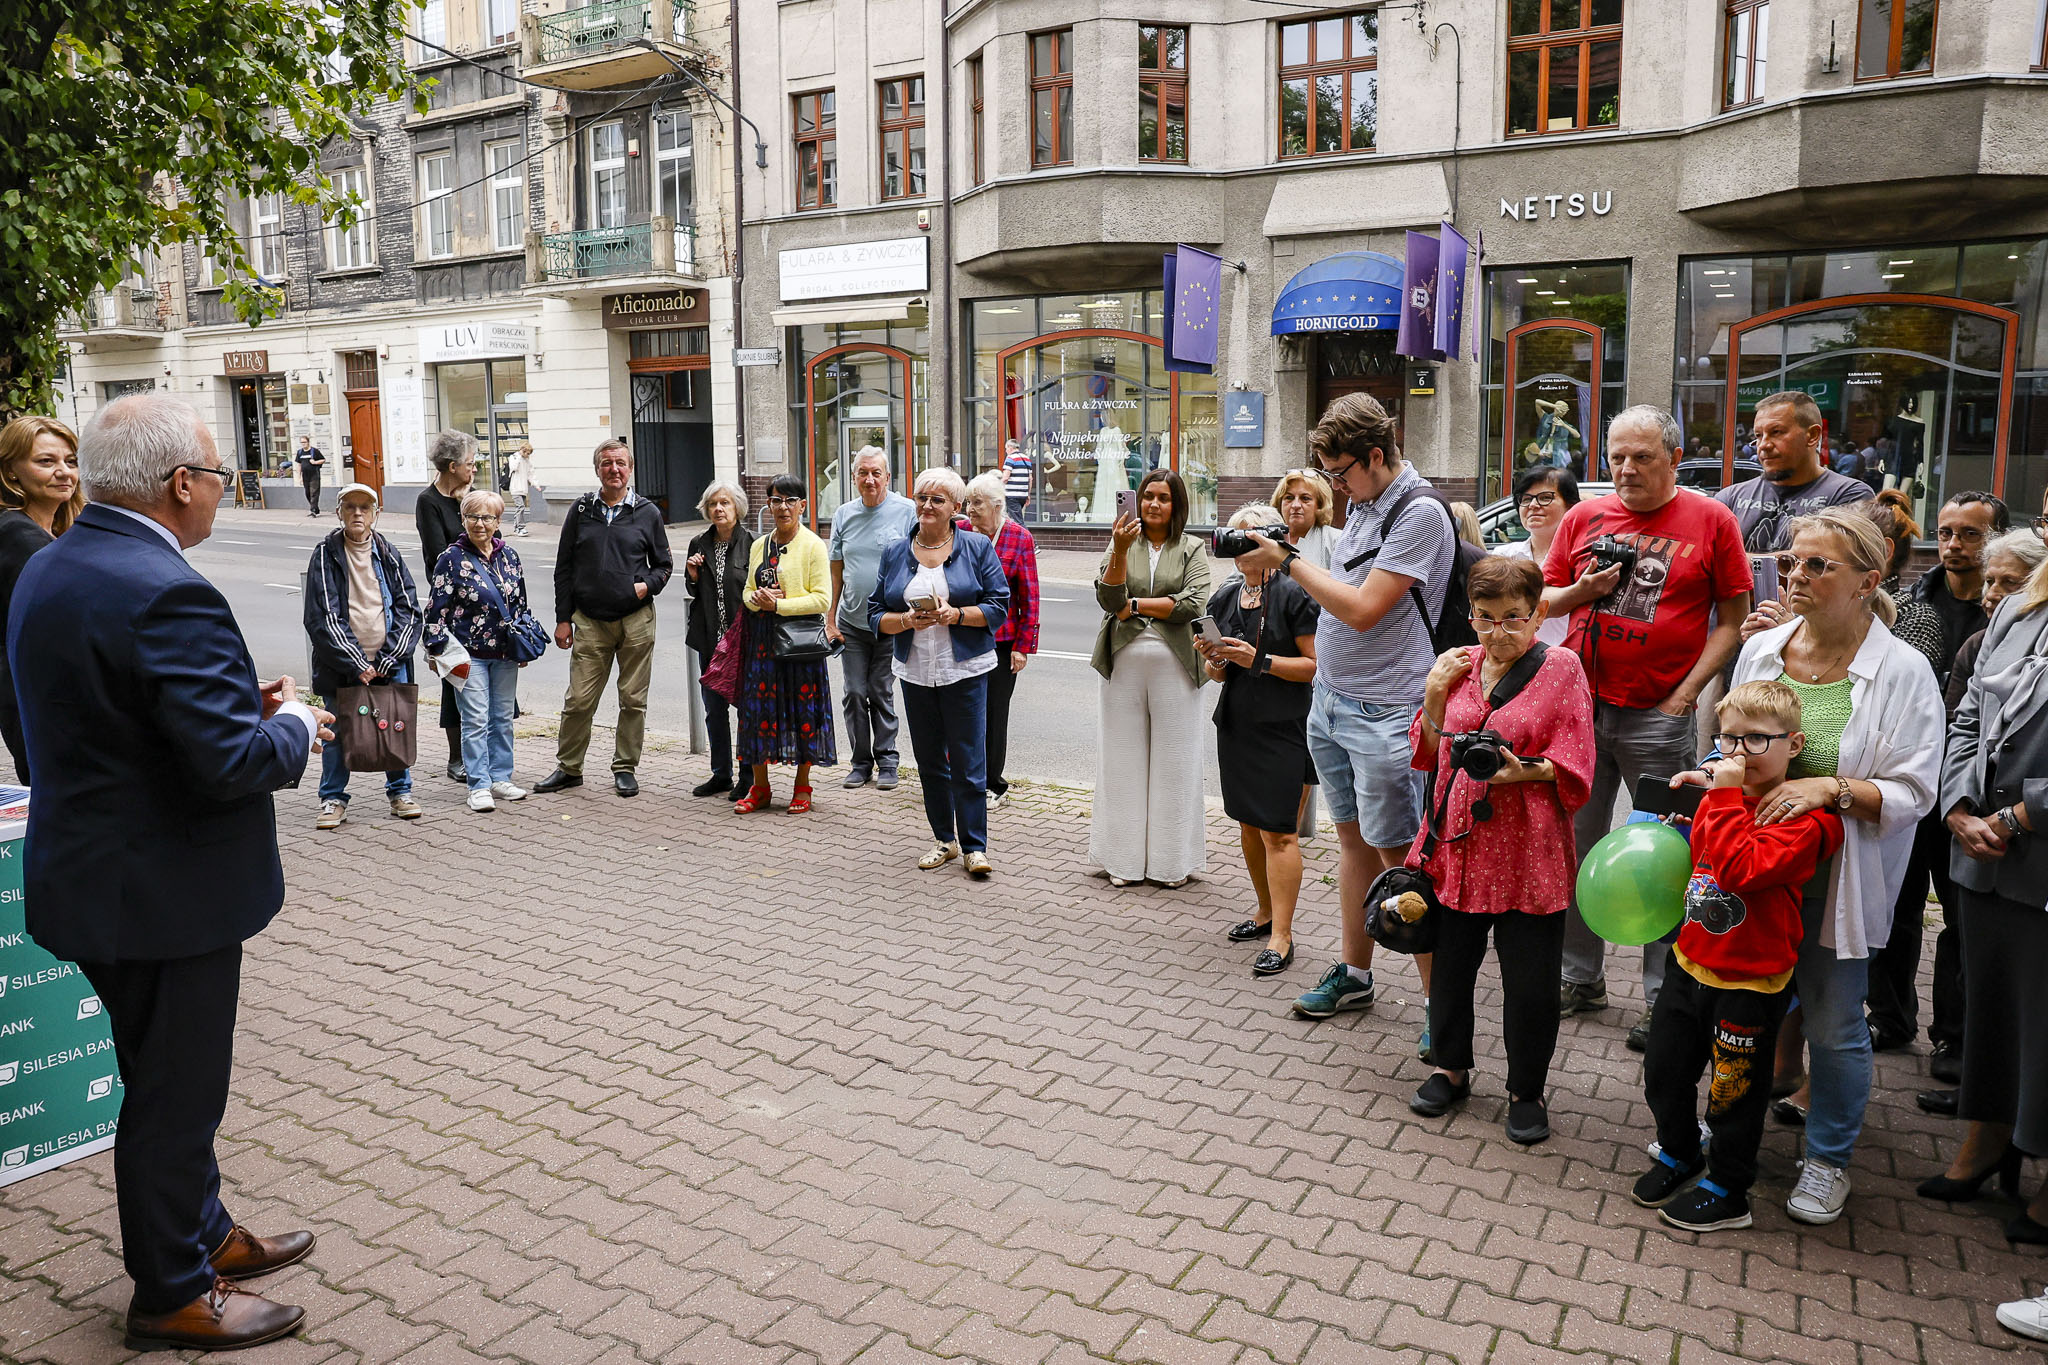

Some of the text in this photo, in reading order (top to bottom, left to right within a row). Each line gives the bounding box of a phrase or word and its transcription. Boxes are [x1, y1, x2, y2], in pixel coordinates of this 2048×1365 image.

[1500, 190, 1613, 221] NETSU
[781, 250, 836, 268] FULARA
[842, 248, 851, 263] &
[611, 291, 696, 315] Aficionado
[629, 314, 678, 325] CIGAR CLUB
[1295, 316, 1379, 331] HORNIGOLD
[1418, 376, 1425, 386] 6
[1044, 398, 1138, 411] FULARA & ŻYWCZYK
[1051, 430, 1131, 446] Najpiękniejsze
[1052, 447, 1131, 460] Polskie Suknie
[11, 964, 74, 990] SILESIA
[0, 1016, 35, 1038] ANK
[1714, 1025, 1718, 1036] I
[1720, 1030, 1754, 1047] HATE
[22, 1037, 115, 1075] SILESIA BAN
[0, 1100, 46, 1126] BANK
[33, 1117, 119, 1158] SILESIA BA
